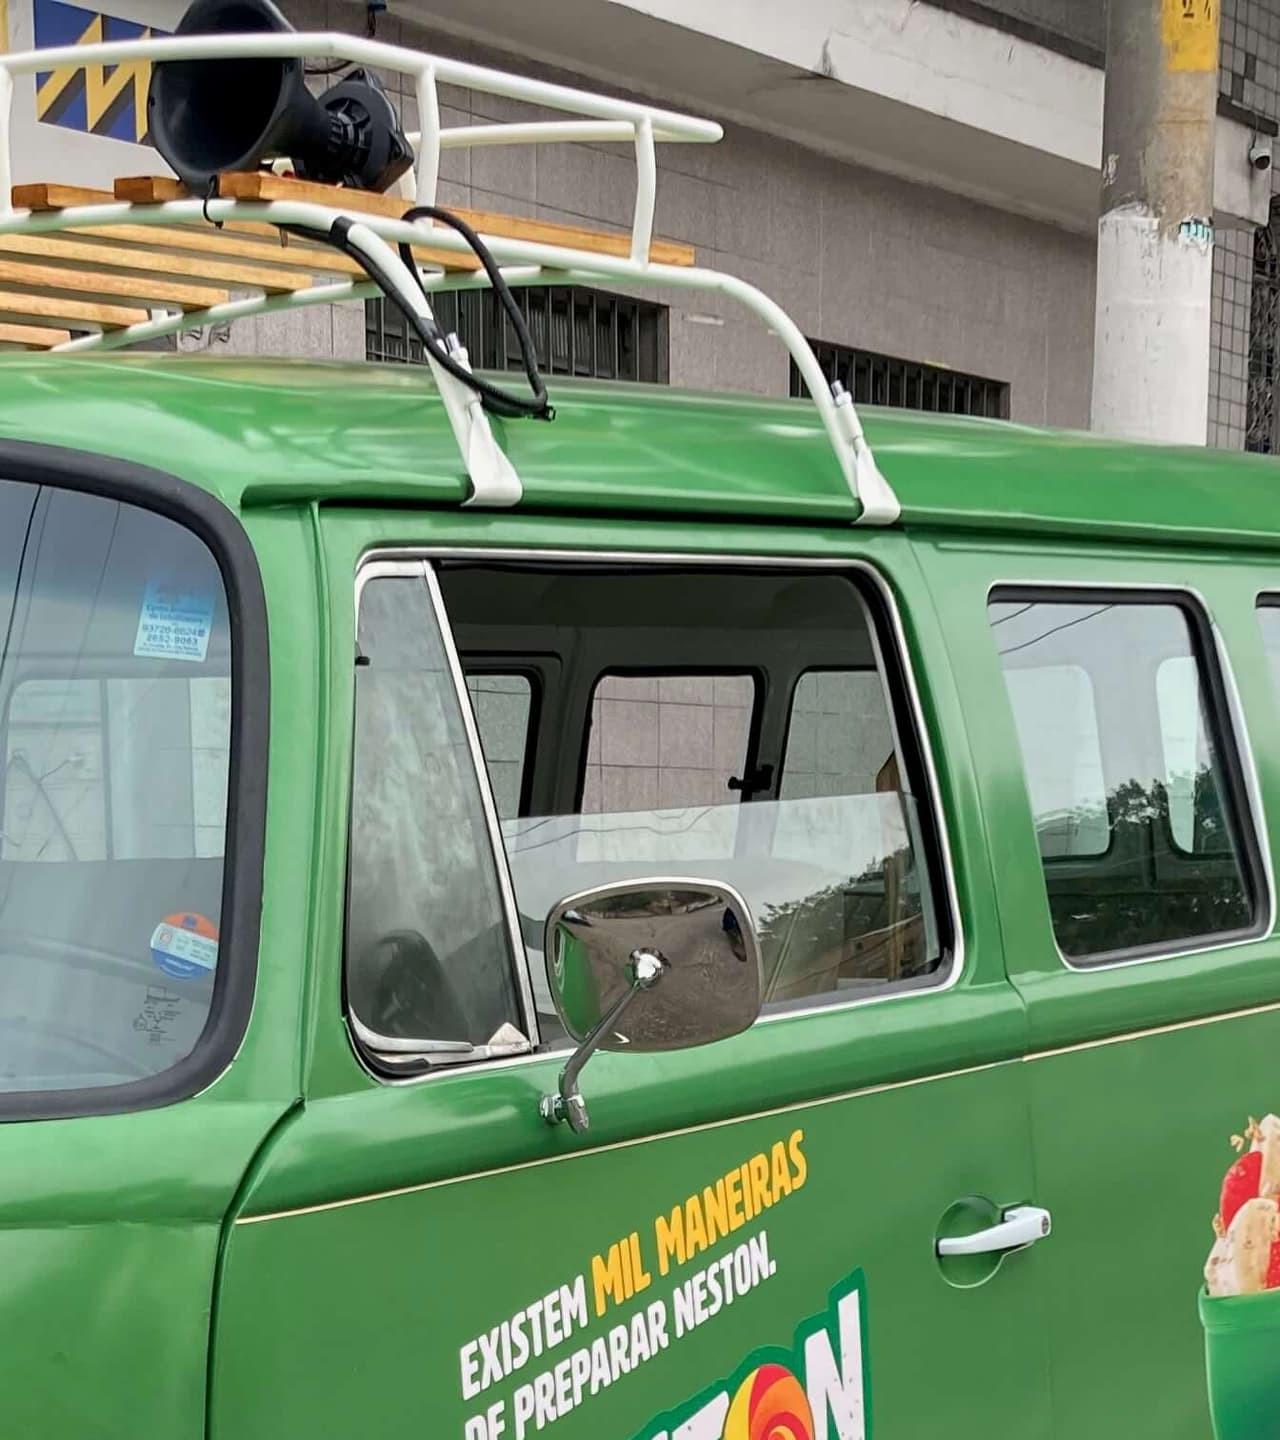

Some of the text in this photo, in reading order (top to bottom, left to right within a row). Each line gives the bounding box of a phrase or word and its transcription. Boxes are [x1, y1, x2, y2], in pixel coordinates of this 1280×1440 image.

[460, 1128, 808, 1401] EXISTEM MIL MANEIRAS
[673, 1231, 777, 1338] NESTON.
